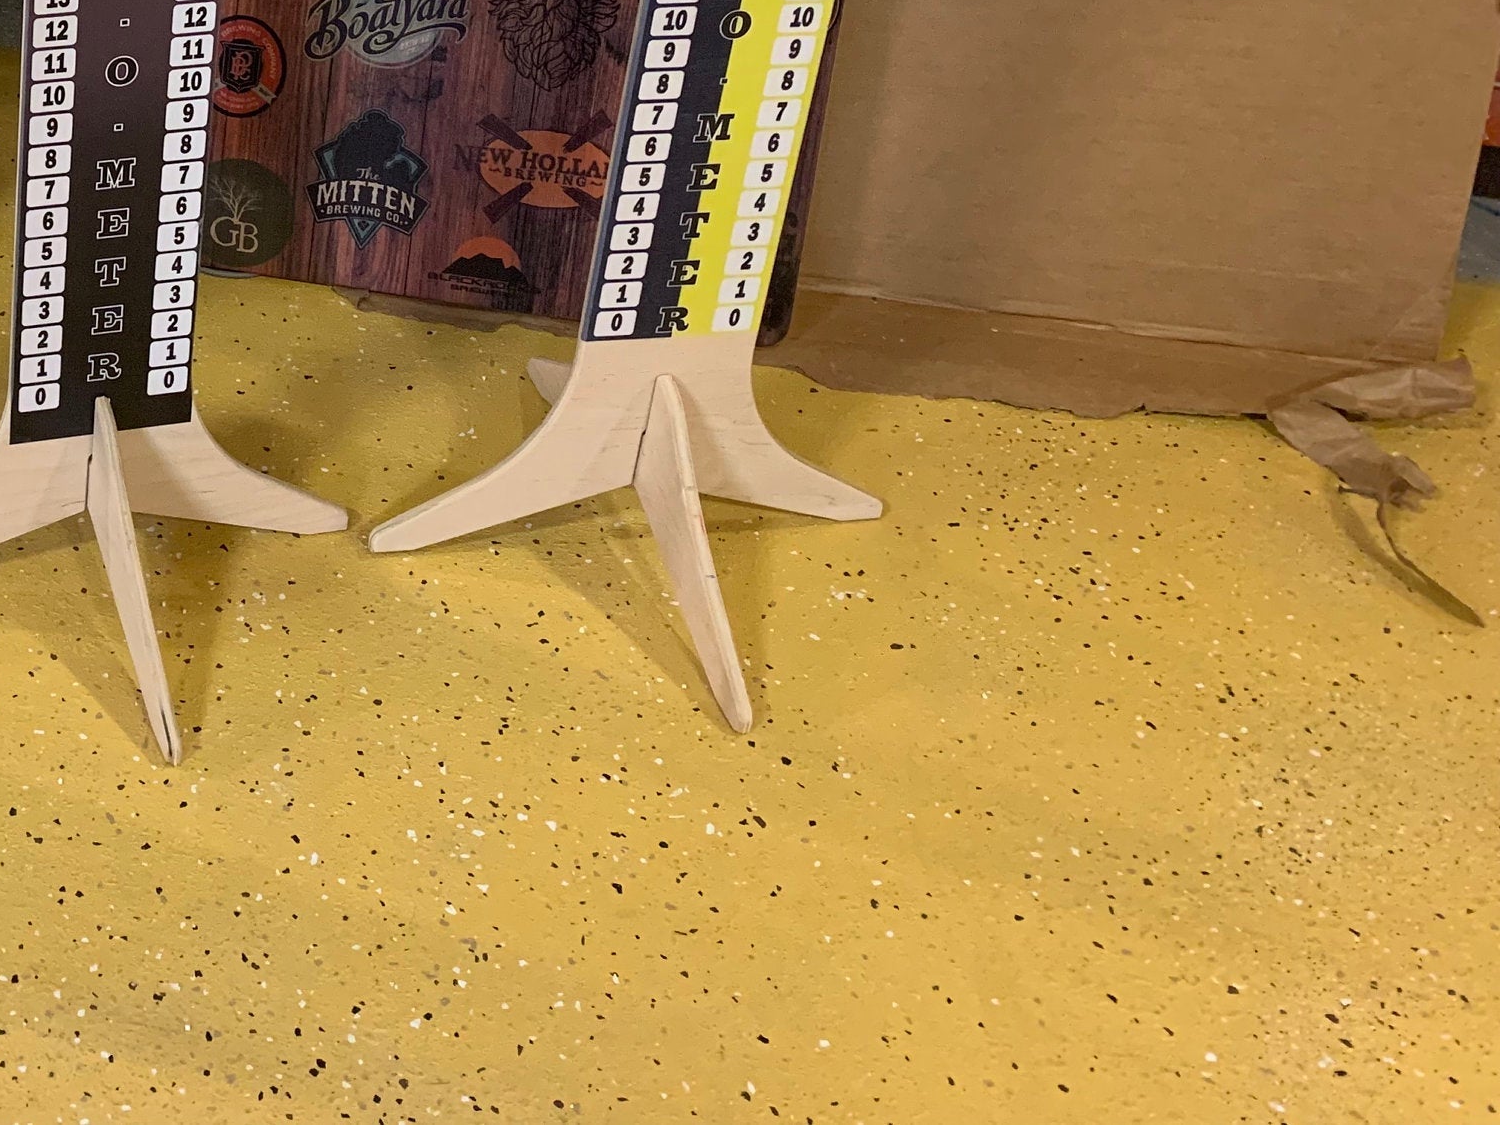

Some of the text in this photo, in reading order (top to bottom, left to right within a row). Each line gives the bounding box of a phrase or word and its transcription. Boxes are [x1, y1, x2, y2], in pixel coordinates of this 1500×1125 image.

[662, 9, 688, 31] 10
[789, 6, 815, 28] 10
[181, 38, 205, 61] 11
[43, 52, 68, 75] 11
[452, 143, 610, 179] NEW HOLLA
[179, 164, 190, 185] 7
[356, 166, 380, 181] The
[503, 168, 588, 189] BREWING
[44, 179, 56, 200] 7
[315, 179, 417, 220] MITTEN
[325, 204, 382, 219] BREWING
[209, 216, 259, 254] GB
[610, 312, 623, 332] 0
[728, 308, 741, 327] 0
[163, 370, 175, 389] 0
[34, 387, 47, 406] 0
